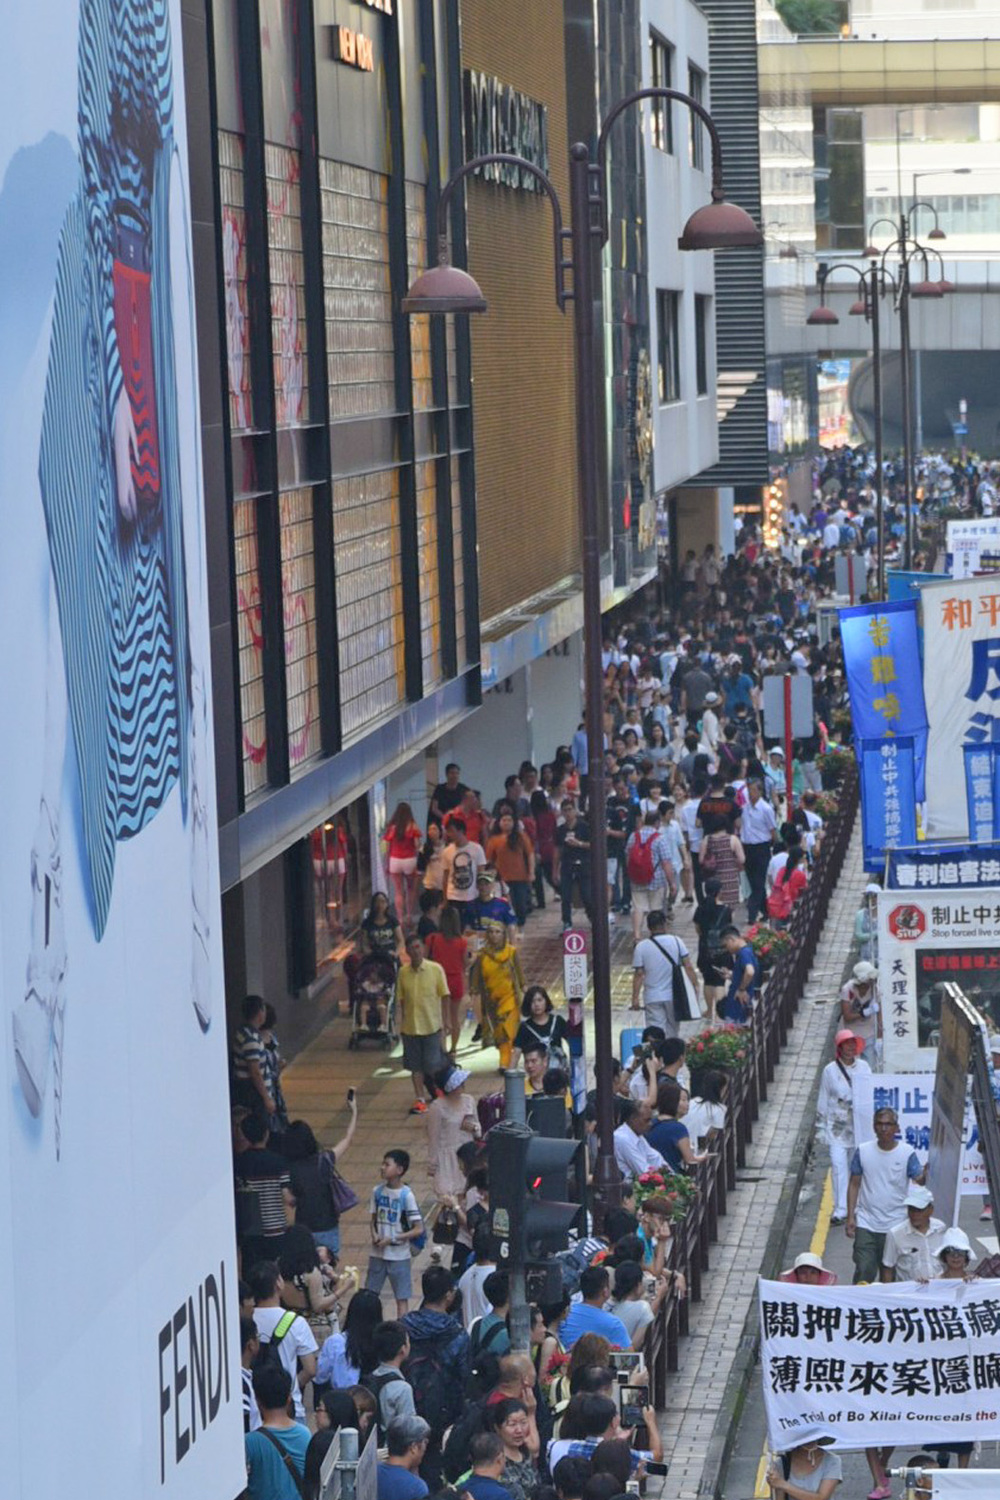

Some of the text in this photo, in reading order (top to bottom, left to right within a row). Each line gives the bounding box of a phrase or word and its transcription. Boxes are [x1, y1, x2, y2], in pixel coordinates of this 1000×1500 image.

[931, 929, 949, 938] Stop
[950, 929, 977, 938] forced
[978, 928, 992, 936] live
[891, 957, 911, 1038] 天理不容
[158, 1260, 231, 1485] FENDI
[828, 1411, 843, 1422] of
[847, 1411, 865, 1422] Bo
[869, 1411, 901, 1422] Xilai
[906, 1411, 972, 1422] Conceals
[975, 1409, 998, 1422] the
